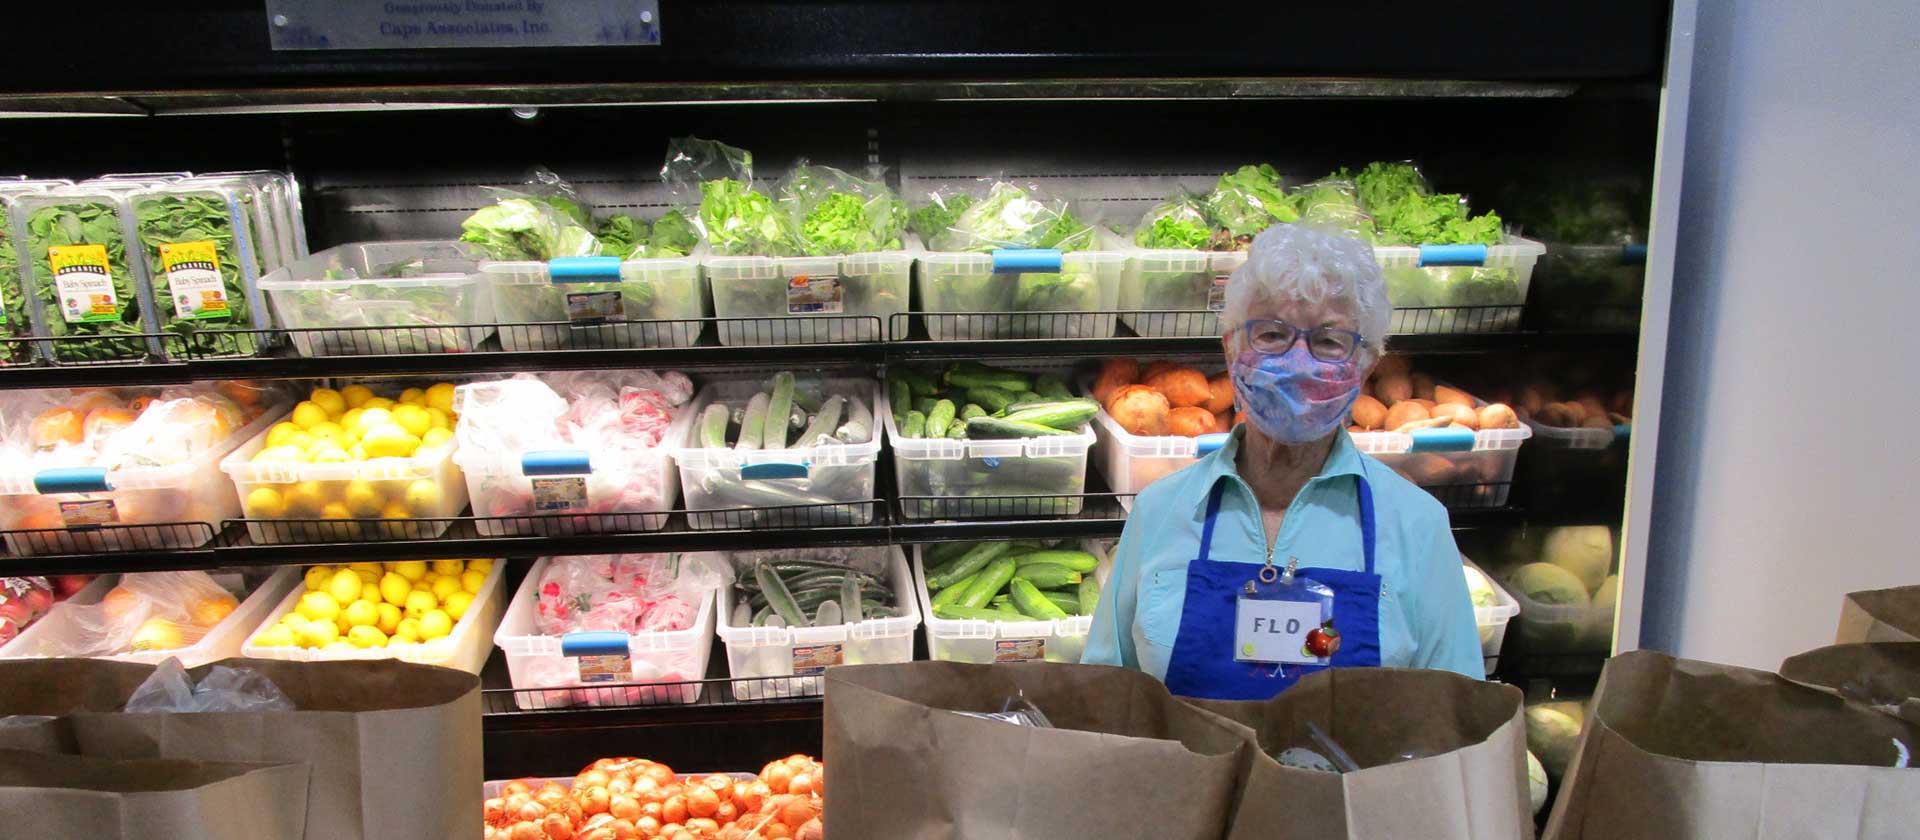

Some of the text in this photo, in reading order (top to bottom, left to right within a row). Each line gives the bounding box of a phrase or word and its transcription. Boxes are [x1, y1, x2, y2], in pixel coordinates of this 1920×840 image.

[383, 0, 545, 15] Generously Donated By
[59, 264, 105, 274] ORGANICS
[171, 261, 214, 271] ORGANICS
[1253, 617, 1300, 634] FLO
